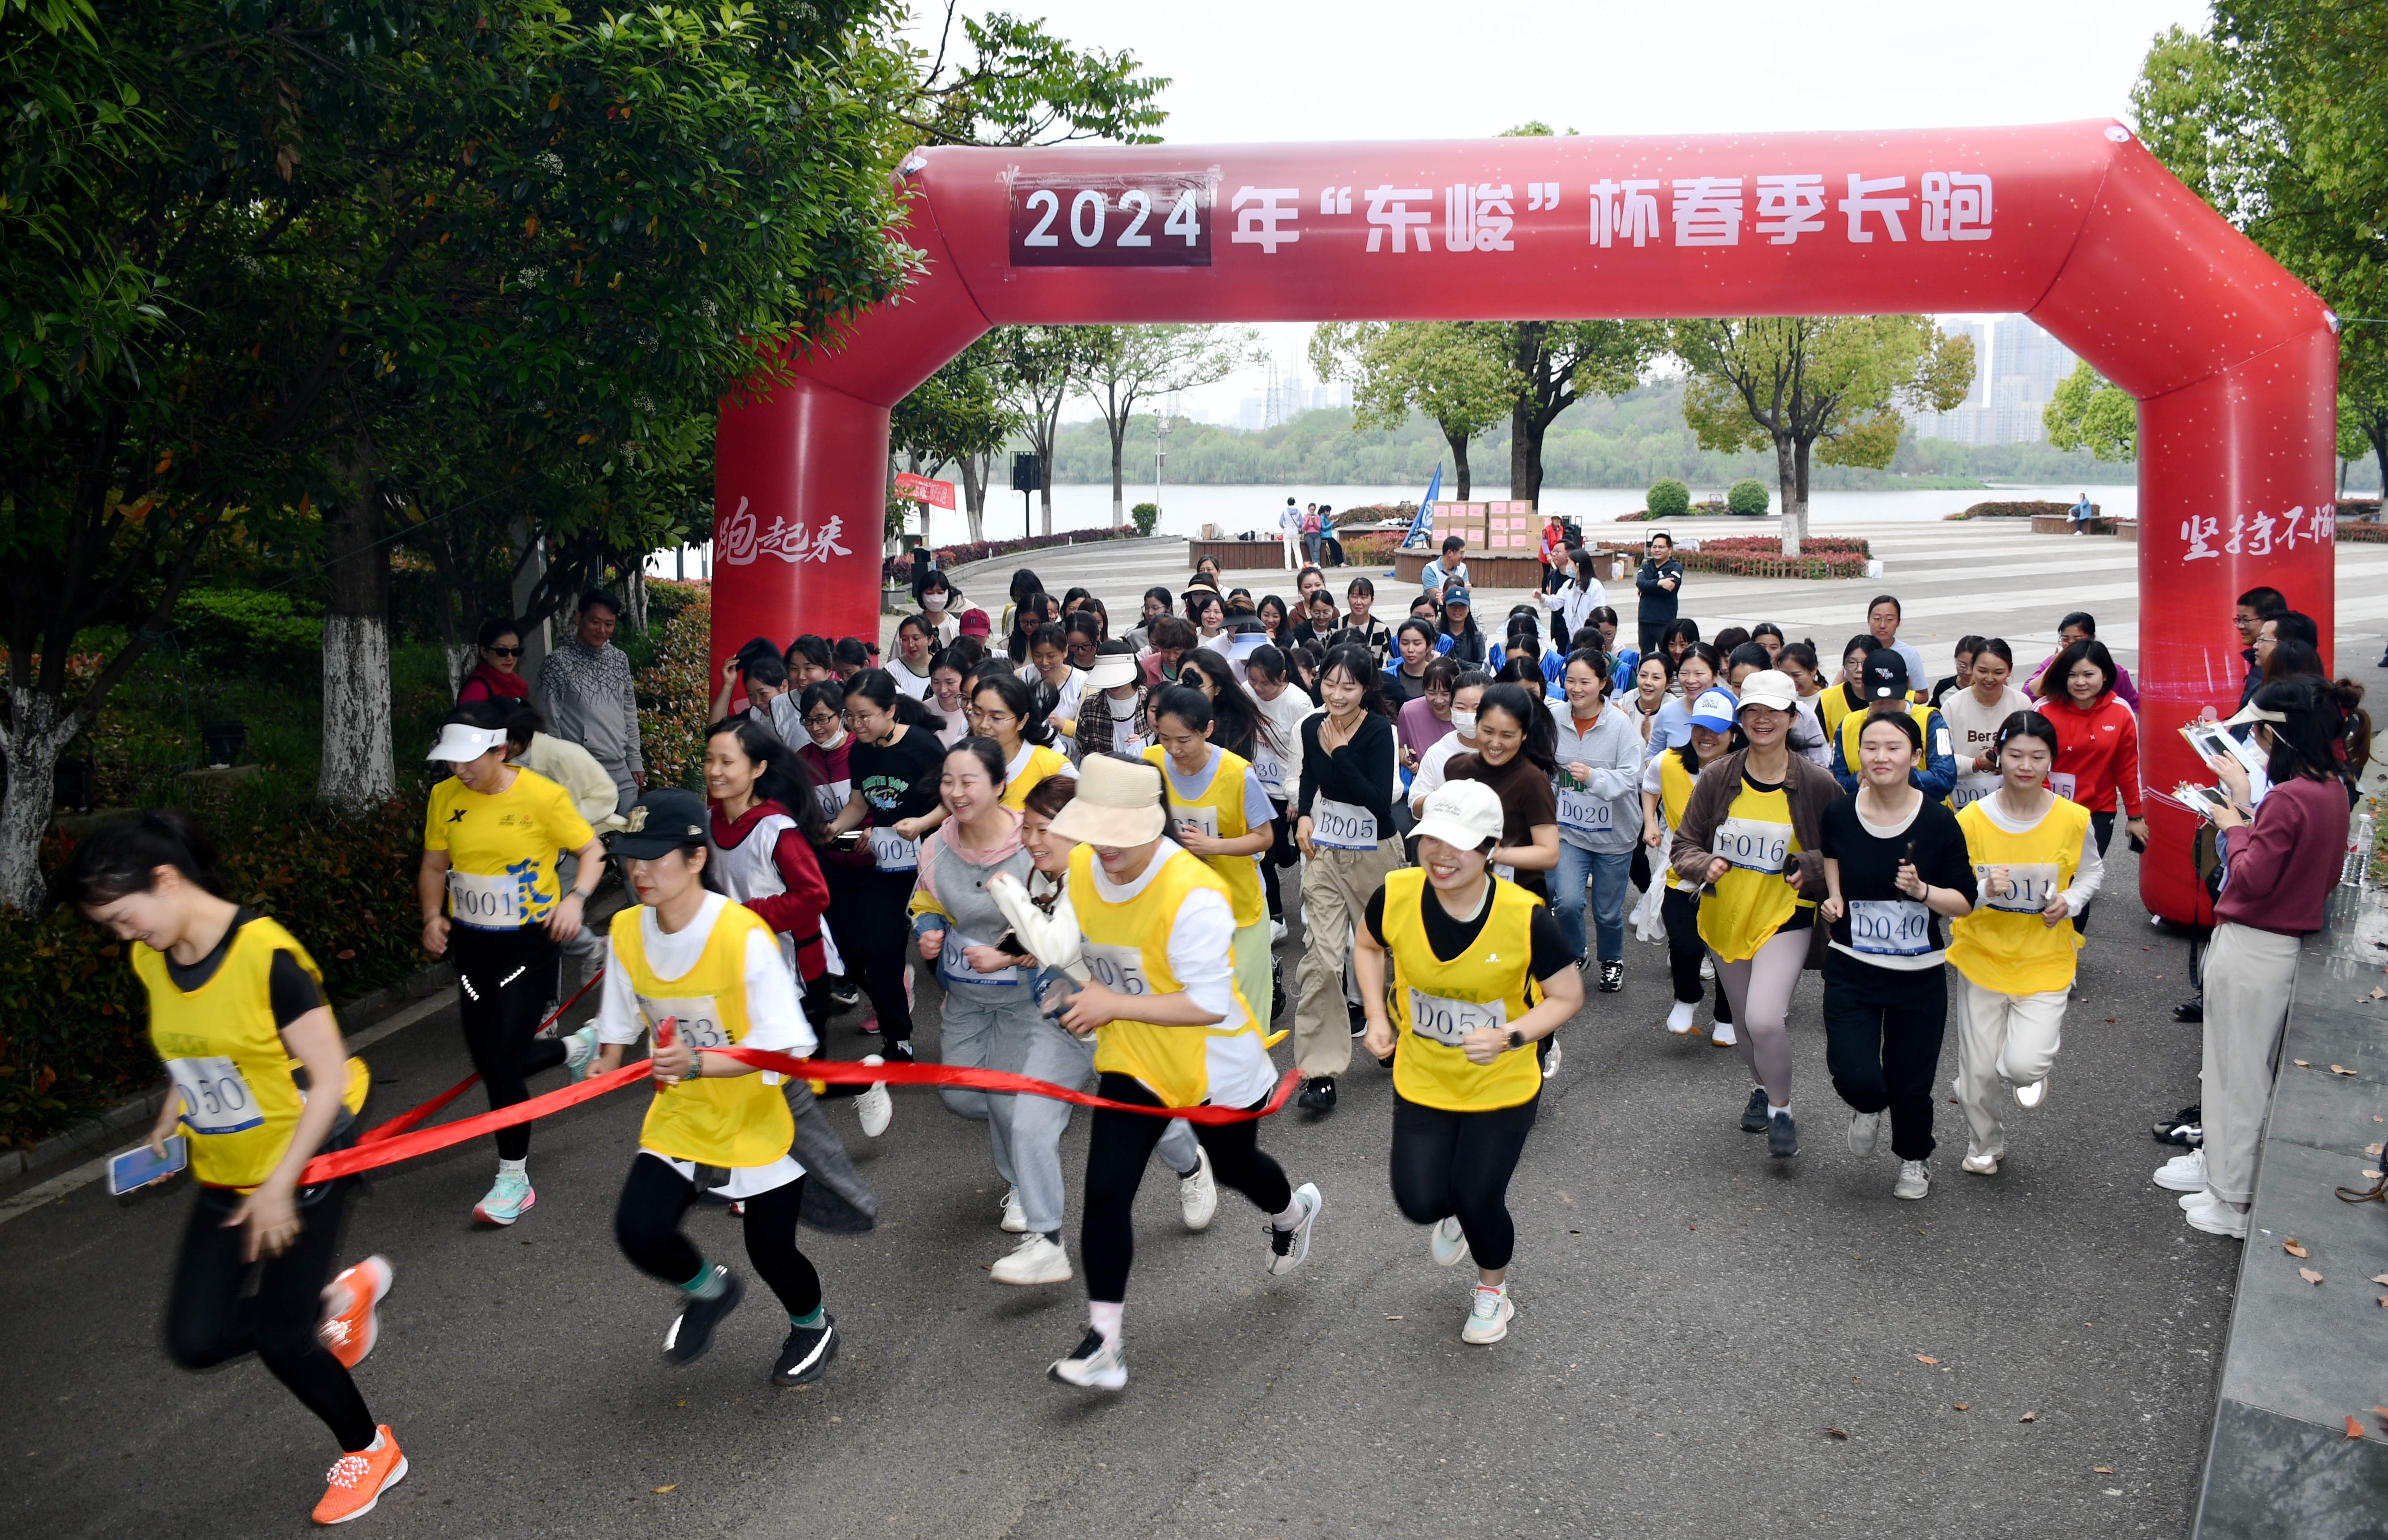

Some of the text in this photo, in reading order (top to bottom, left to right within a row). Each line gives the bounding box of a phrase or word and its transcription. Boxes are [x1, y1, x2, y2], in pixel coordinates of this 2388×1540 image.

[716, 495, 853, 566] 跑起来
[1320, 811, 1373, 839] B005
[1562, 799, 1609, 823] D020
[1718, 832, 1785, 863] F016
[454, 885, 515, 917] F001
[1856, 913, 1924, 940] D040
